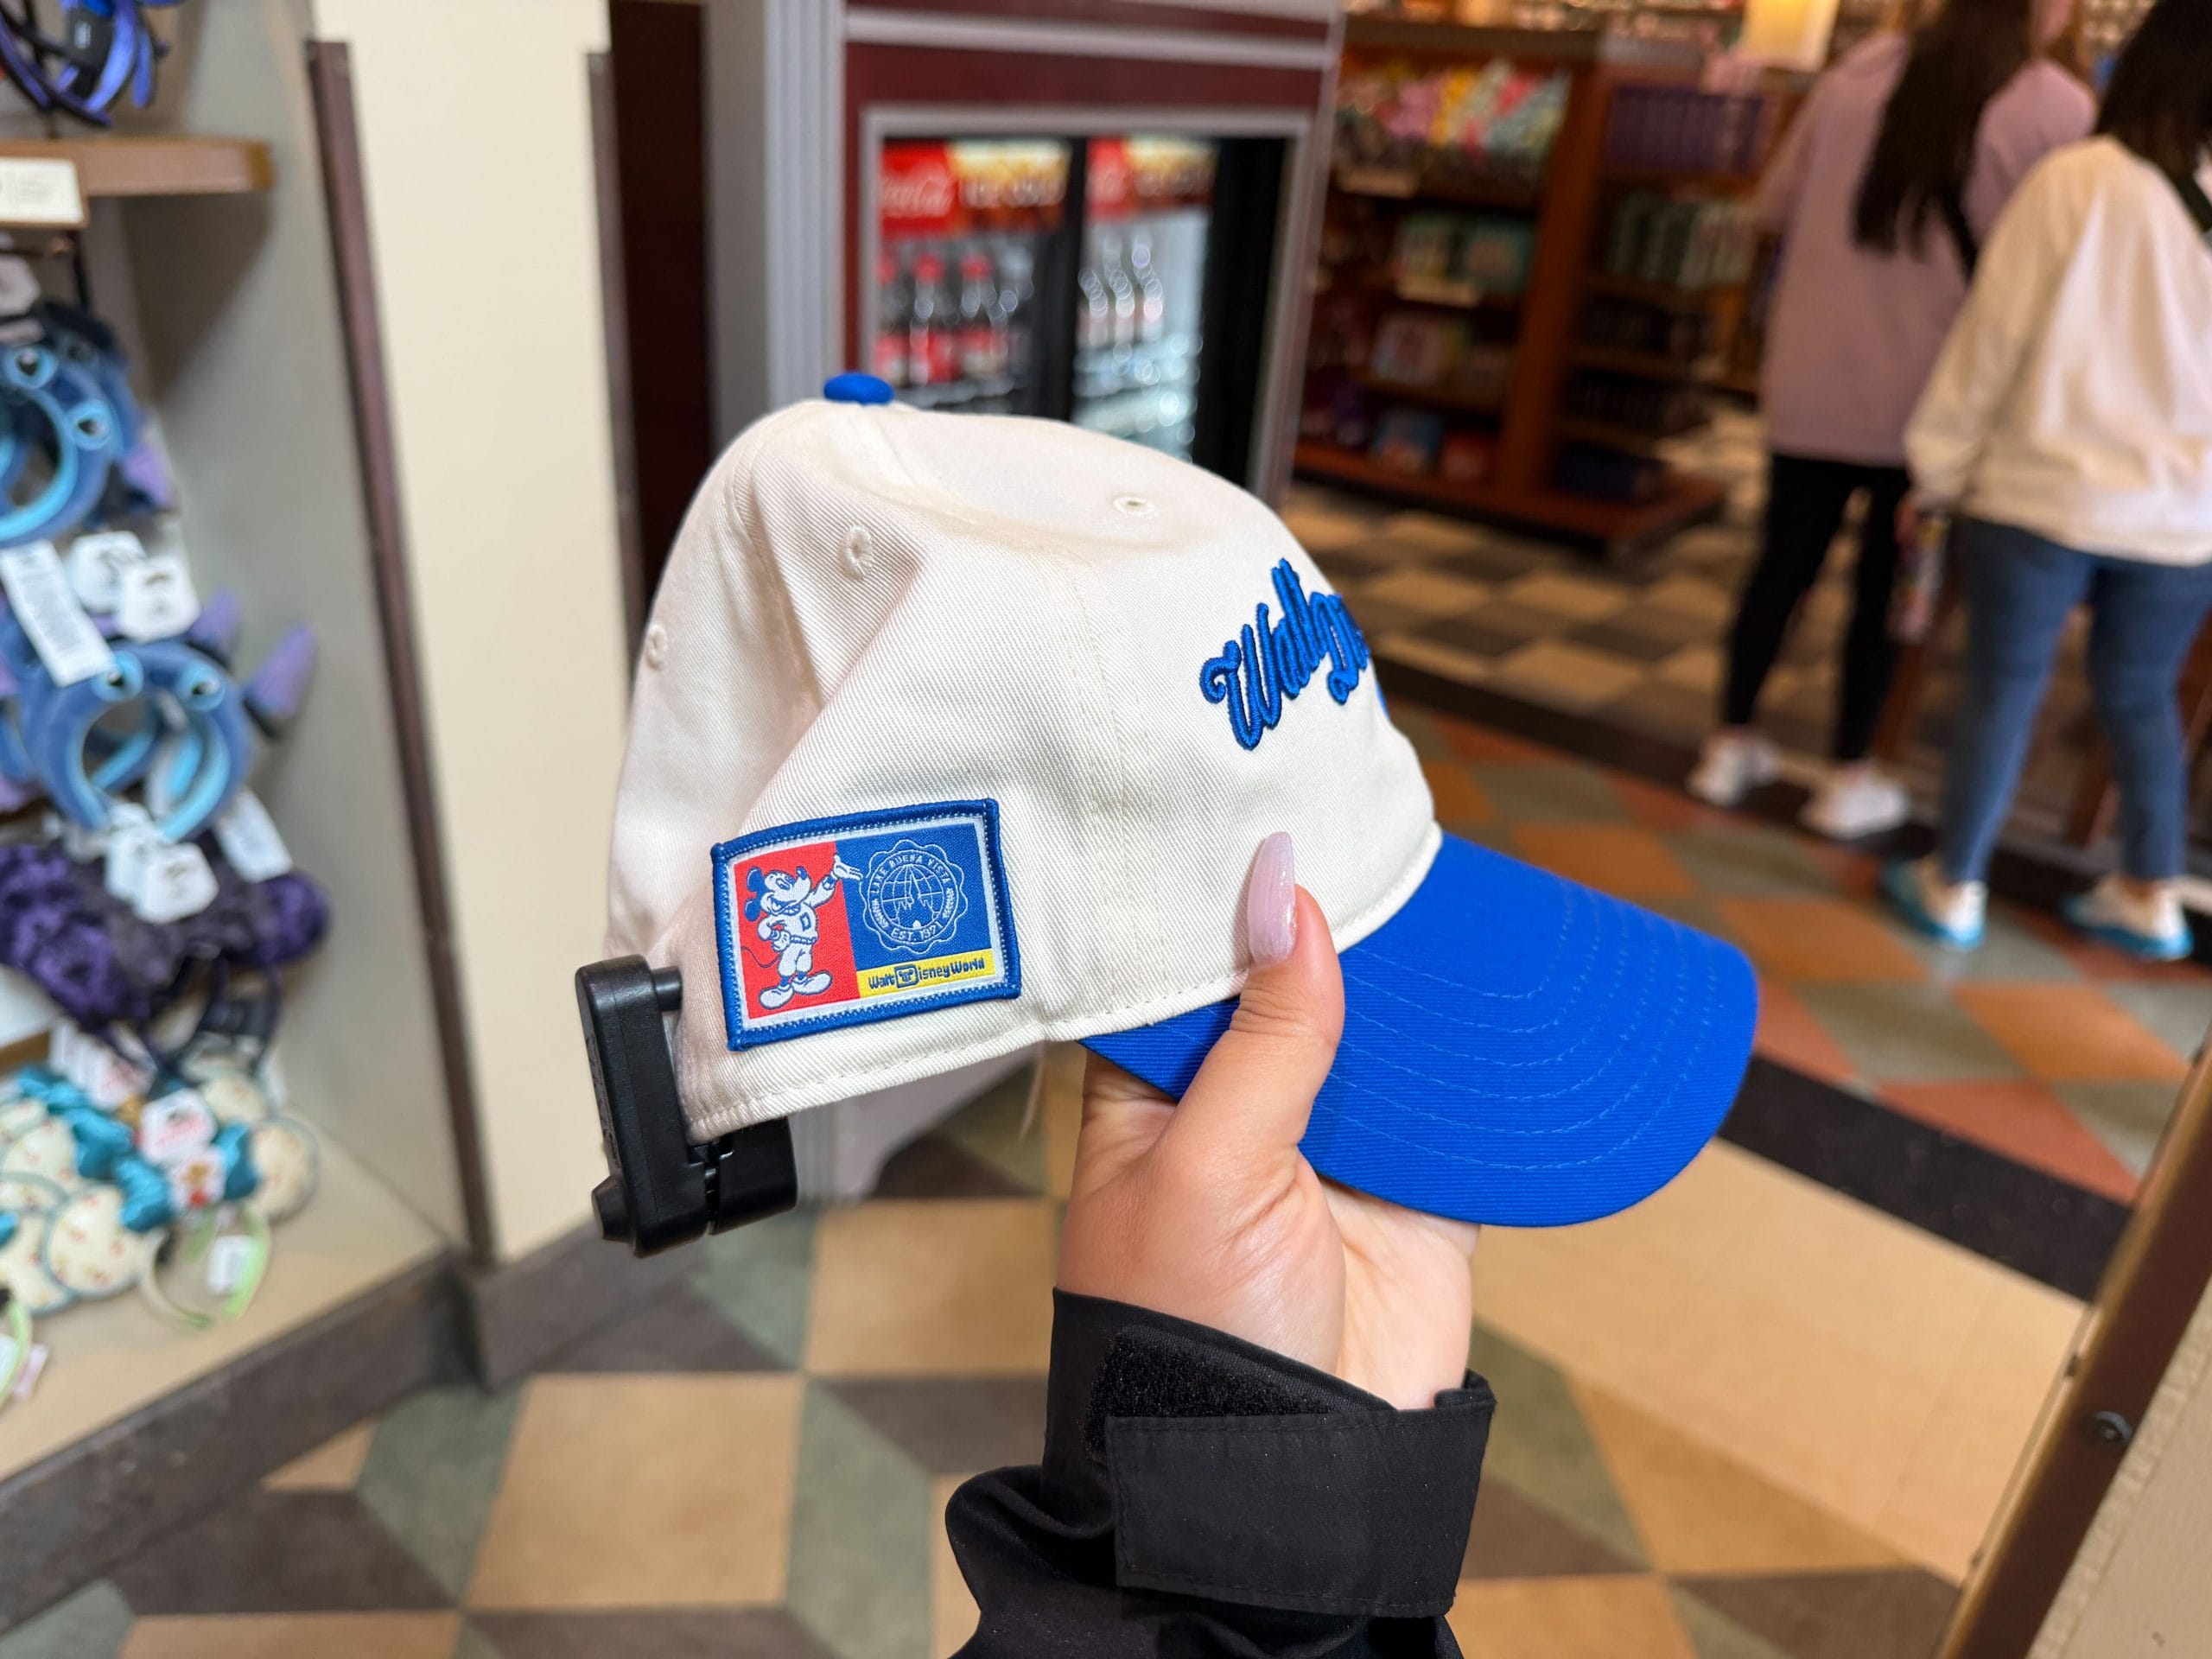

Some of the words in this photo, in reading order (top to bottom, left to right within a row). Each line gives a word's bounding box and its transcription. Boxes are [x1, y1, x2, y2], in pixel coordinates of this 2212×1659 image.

[870, 867, 889, 894] LAKE
[888, 855, 923, 867] BUENA
[928, 857, 951, 884] VISTA
[892, 928, 917, 942] EST.
[919, 921, 944, 941] 1971
[868, 974, 895, 989] Walt
[950, 957, 985, 974] World
